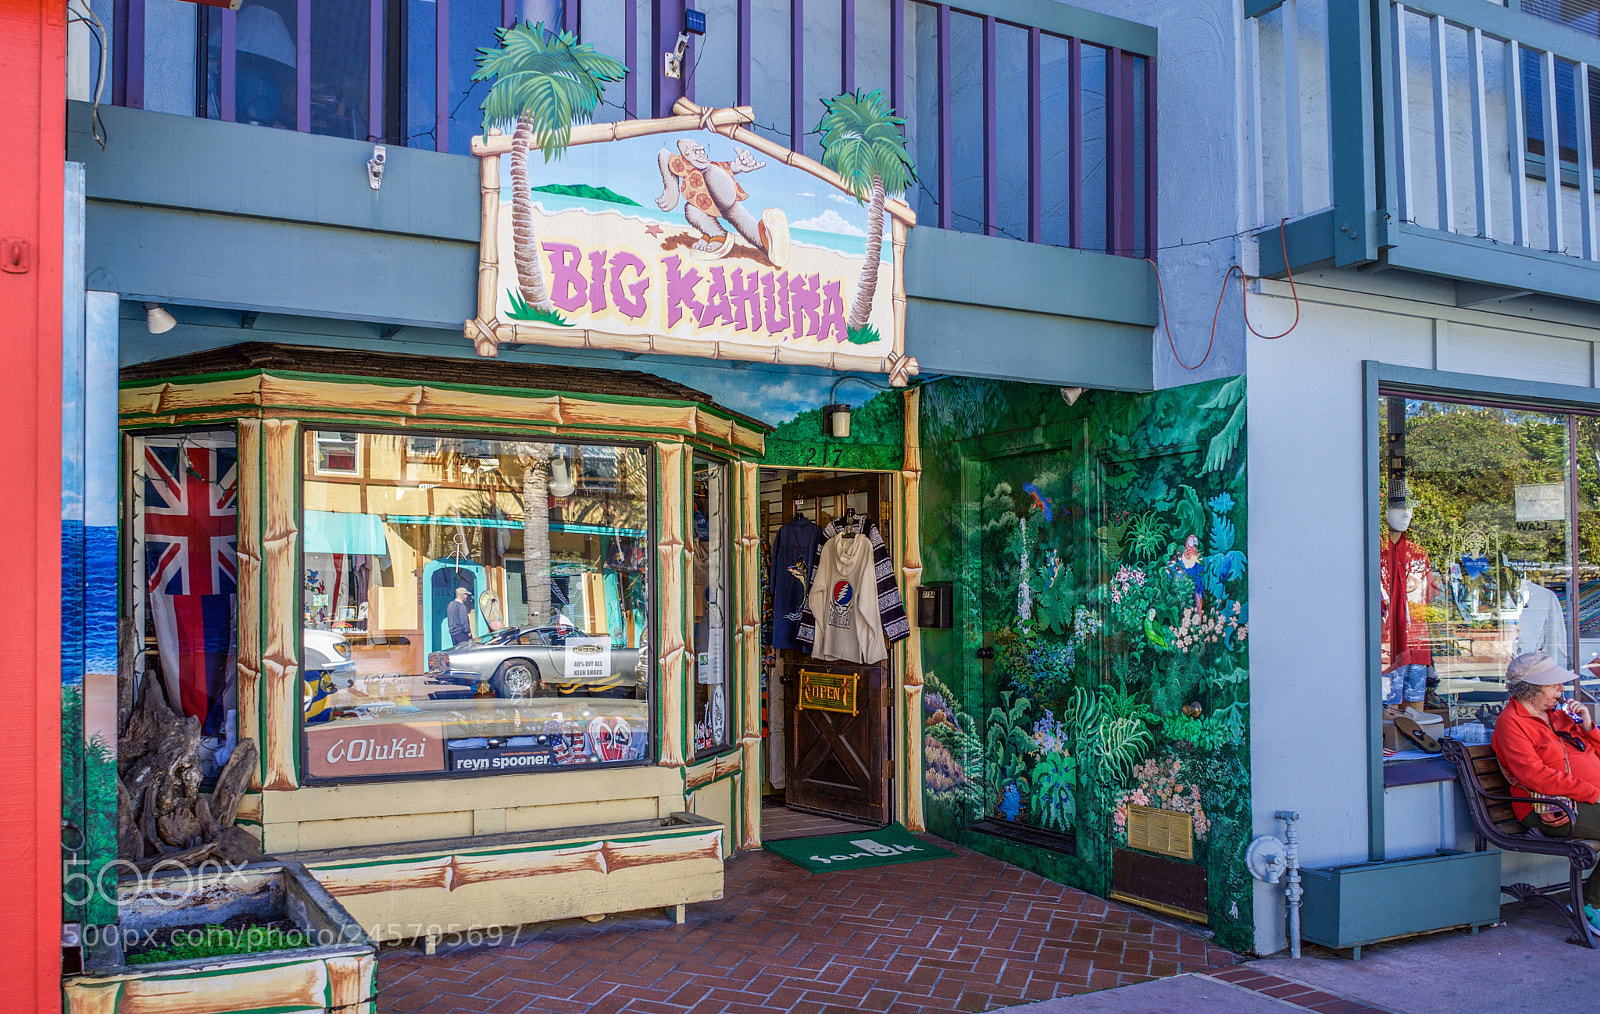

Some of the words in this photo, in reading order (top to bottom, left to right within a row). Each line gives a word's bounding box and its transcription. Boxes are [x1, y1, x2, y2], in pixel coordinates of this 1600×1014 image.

[541, 241, 649, 320] BIG
[660, 254, 849, 344] KAHUNA
[806, 447, 843, 468] 217
[812, 685, 840, 700] OPEN
[346, 738, 427, 763] OluKai
[457, 758, 490, 771] reyn
